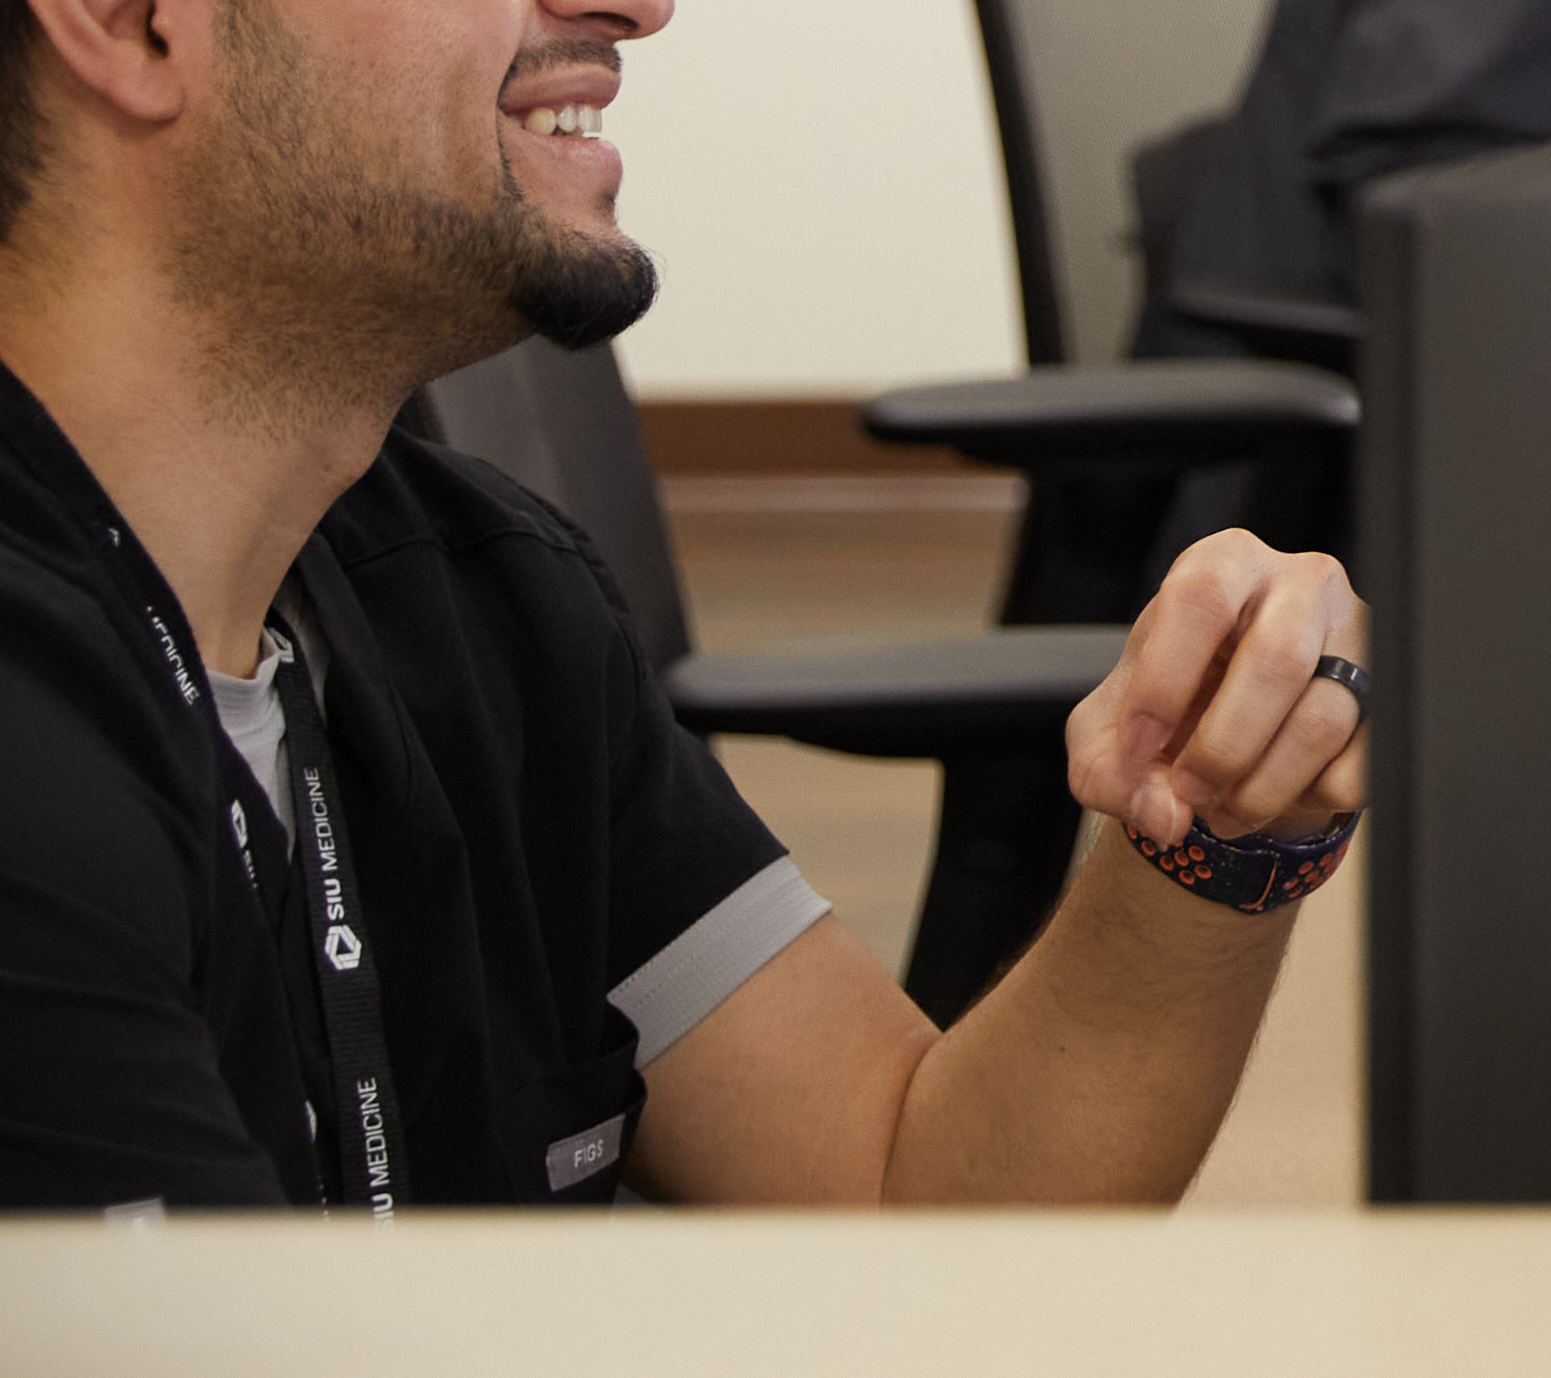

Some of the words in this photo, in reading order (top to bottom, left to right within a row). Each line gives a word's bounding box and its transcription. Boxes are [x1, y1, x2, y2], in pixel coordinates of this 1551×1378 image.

[305, 767, 338, 871] MEDICINE
[325, 879, 344, 921] SIU
[358, 1077, 390, 1187] MEDICINE
[574, 1139, 603, 1168] FIGS
